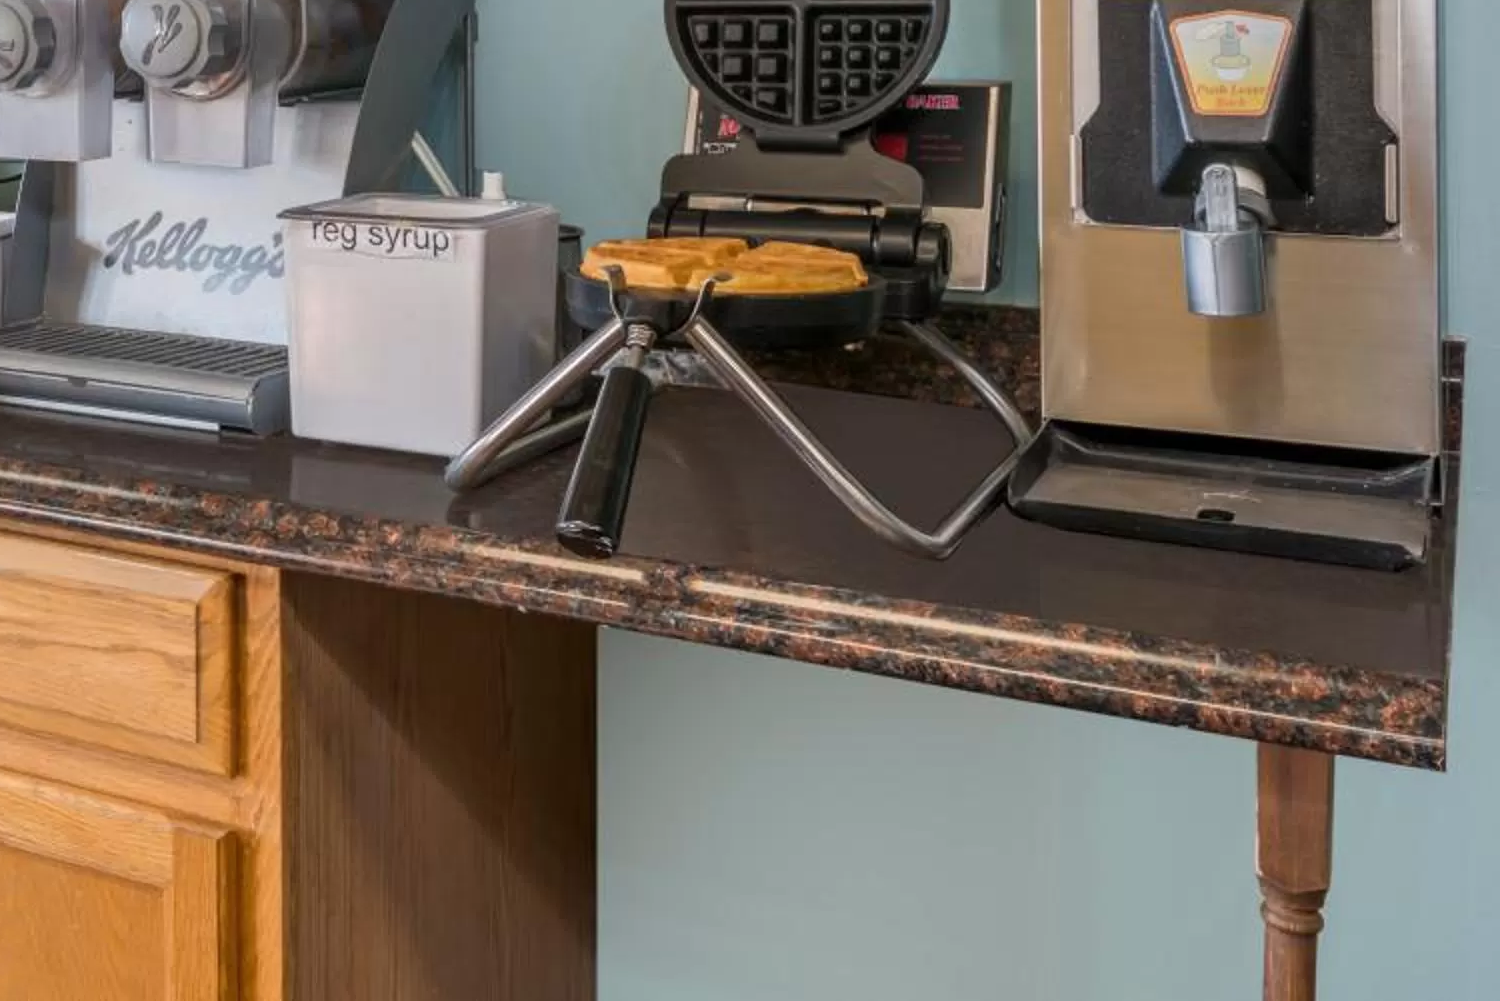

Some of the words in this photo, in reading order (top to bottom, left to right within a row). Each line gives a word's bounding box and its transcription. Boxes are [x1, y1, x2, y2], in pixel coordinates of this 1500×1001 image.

[103, 210, 285, 295] Kellogg's
[312, 219, 357, 250] reg
[368, 224, 450, 256] syrup
